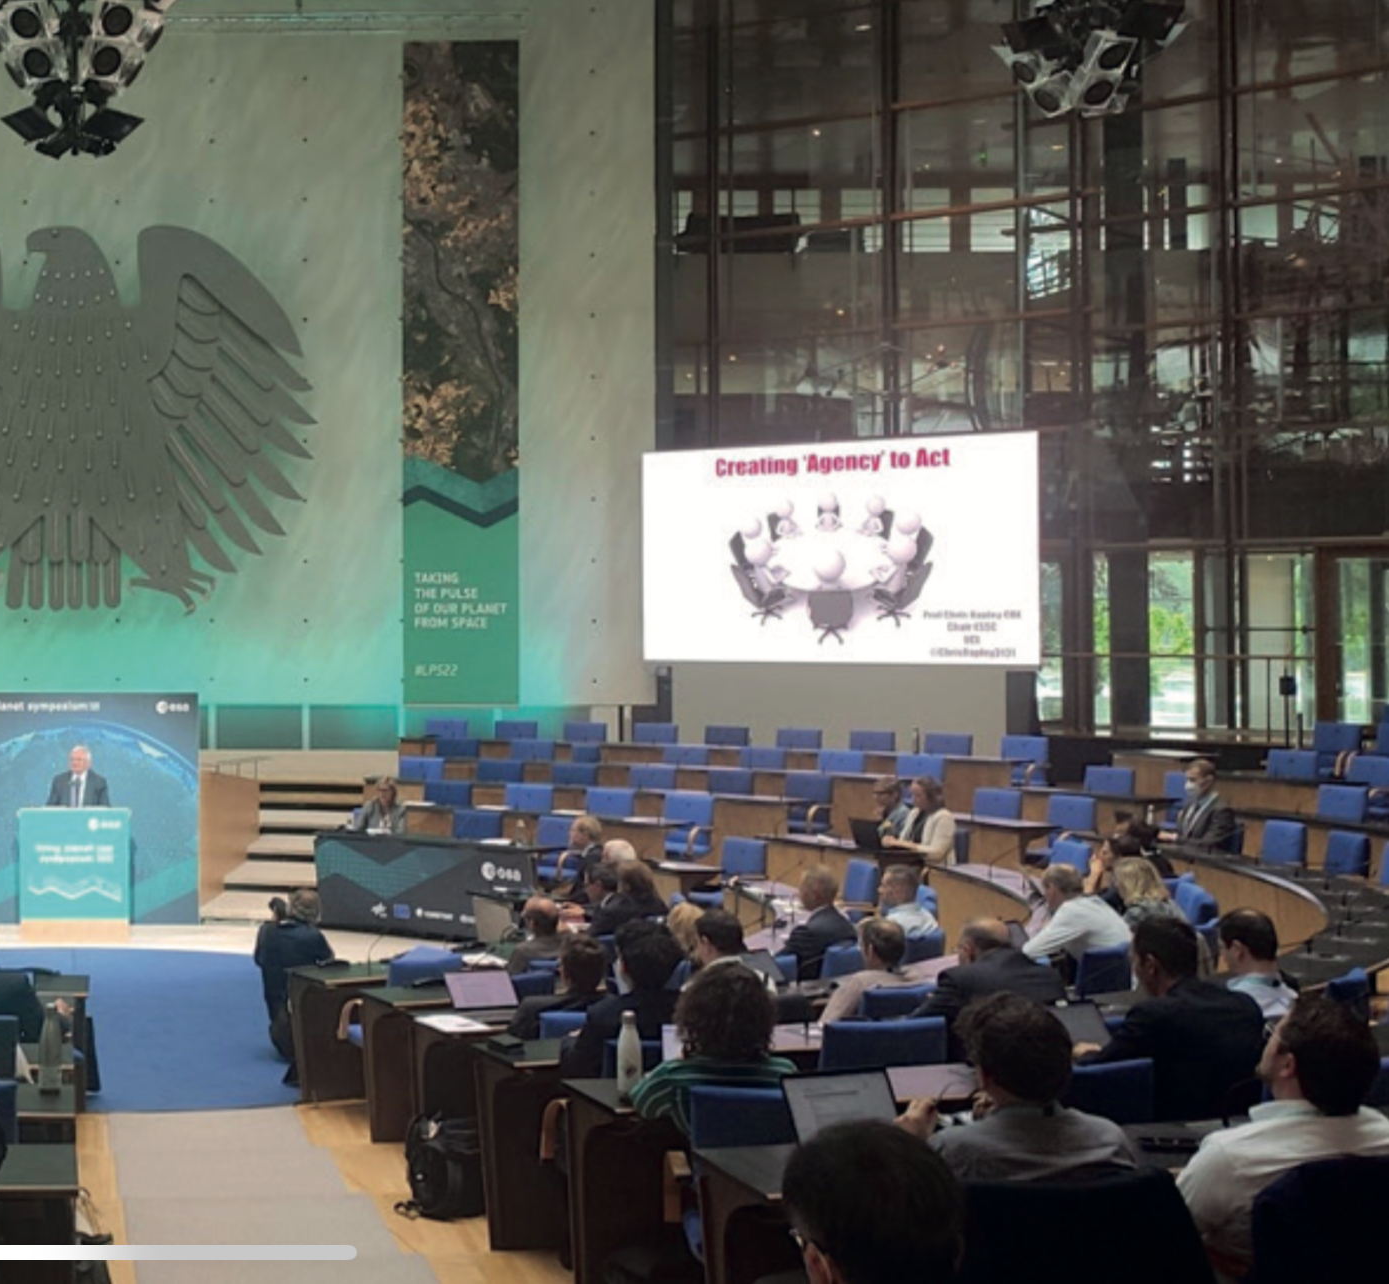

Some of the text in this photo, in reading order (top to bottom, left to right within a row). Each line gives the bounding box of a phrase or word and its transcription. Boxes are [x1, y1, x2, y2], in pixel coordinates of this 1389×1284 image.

[715, 457, 798, 477] Creating
[890, 450, 911, 469] to
[915, 447, 951, 467] Act
[414, 572, 458, 584] TAKING
[414, 588, 478, 599] THE PULSE
[414, 602, 508, 615] OF OUR PLANET
[414, 617, 488, 629] FROM SPACE
[414, 663, 458, 676] #LPS22
[27, 700, 88, 714] symposium
